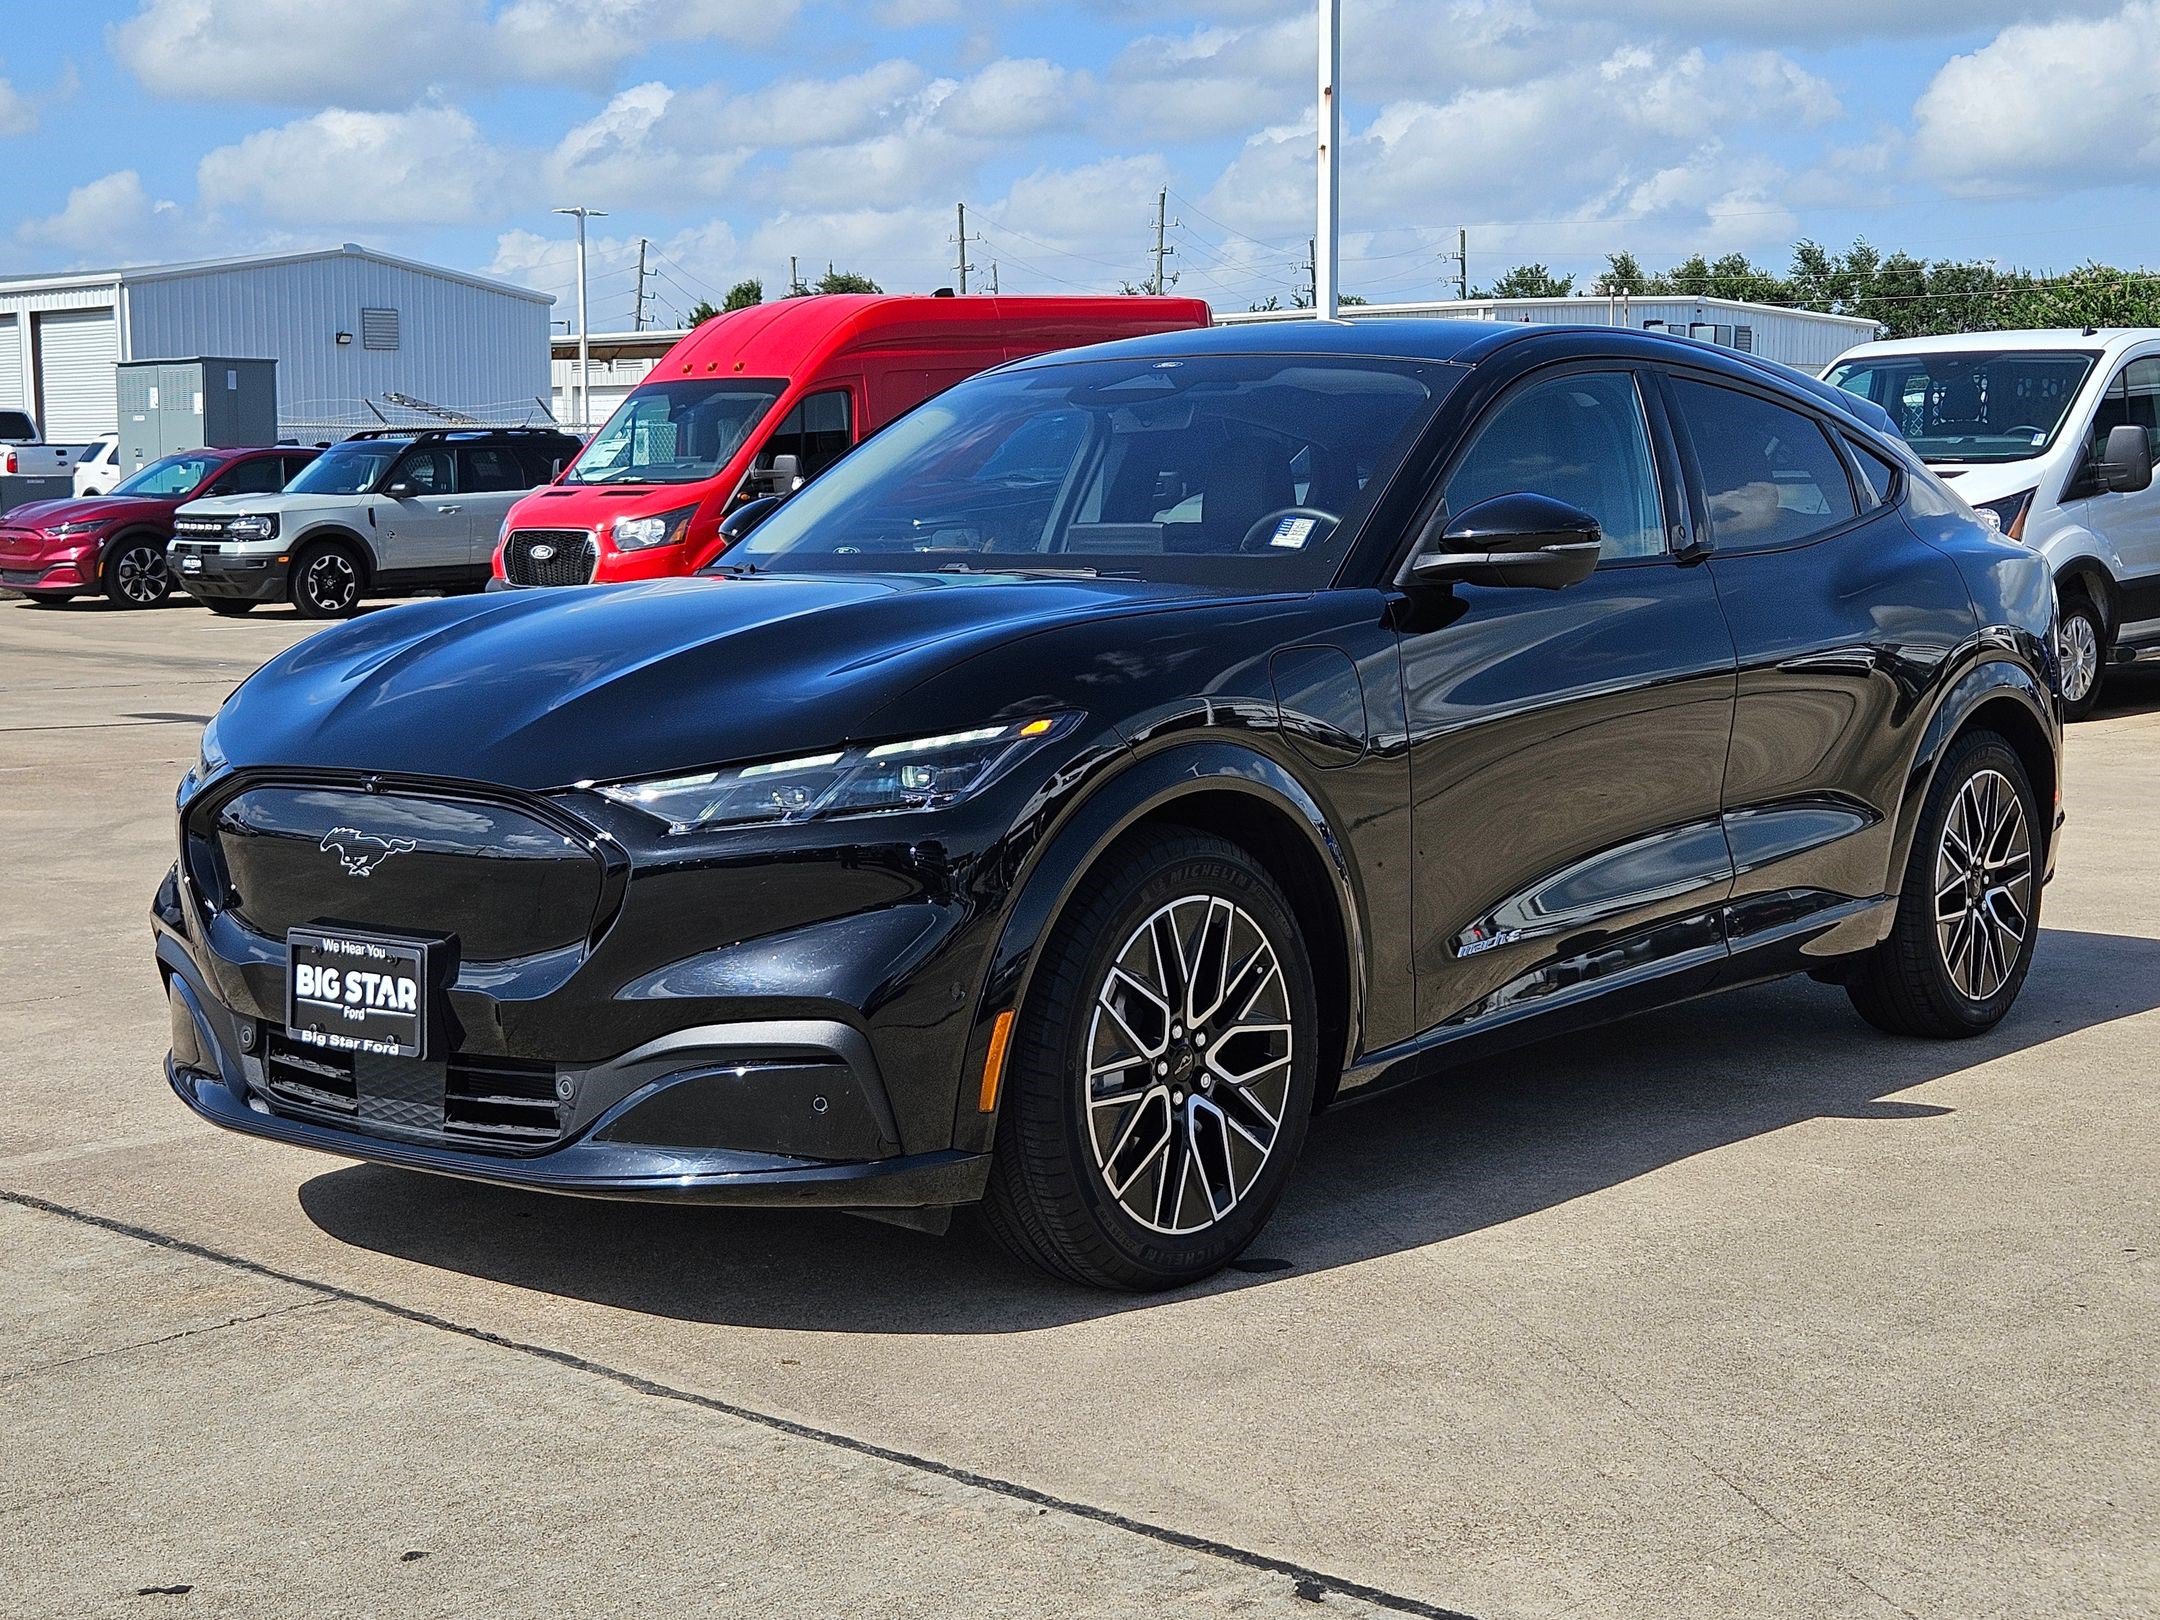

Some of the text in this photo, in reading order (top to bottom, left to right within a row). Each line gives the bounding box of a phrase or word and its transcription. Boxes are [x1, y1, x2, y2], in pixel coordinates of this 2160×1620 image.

[1169, 863, 1249, 890] MICHELIN
[322, 938, 386, 959] We Hear You
[296, 963, 417, 1011] BIG STAR
[343, 1005, 365, 1021] Ford
[302, 1030, 399, 1056] Big Star Ford
